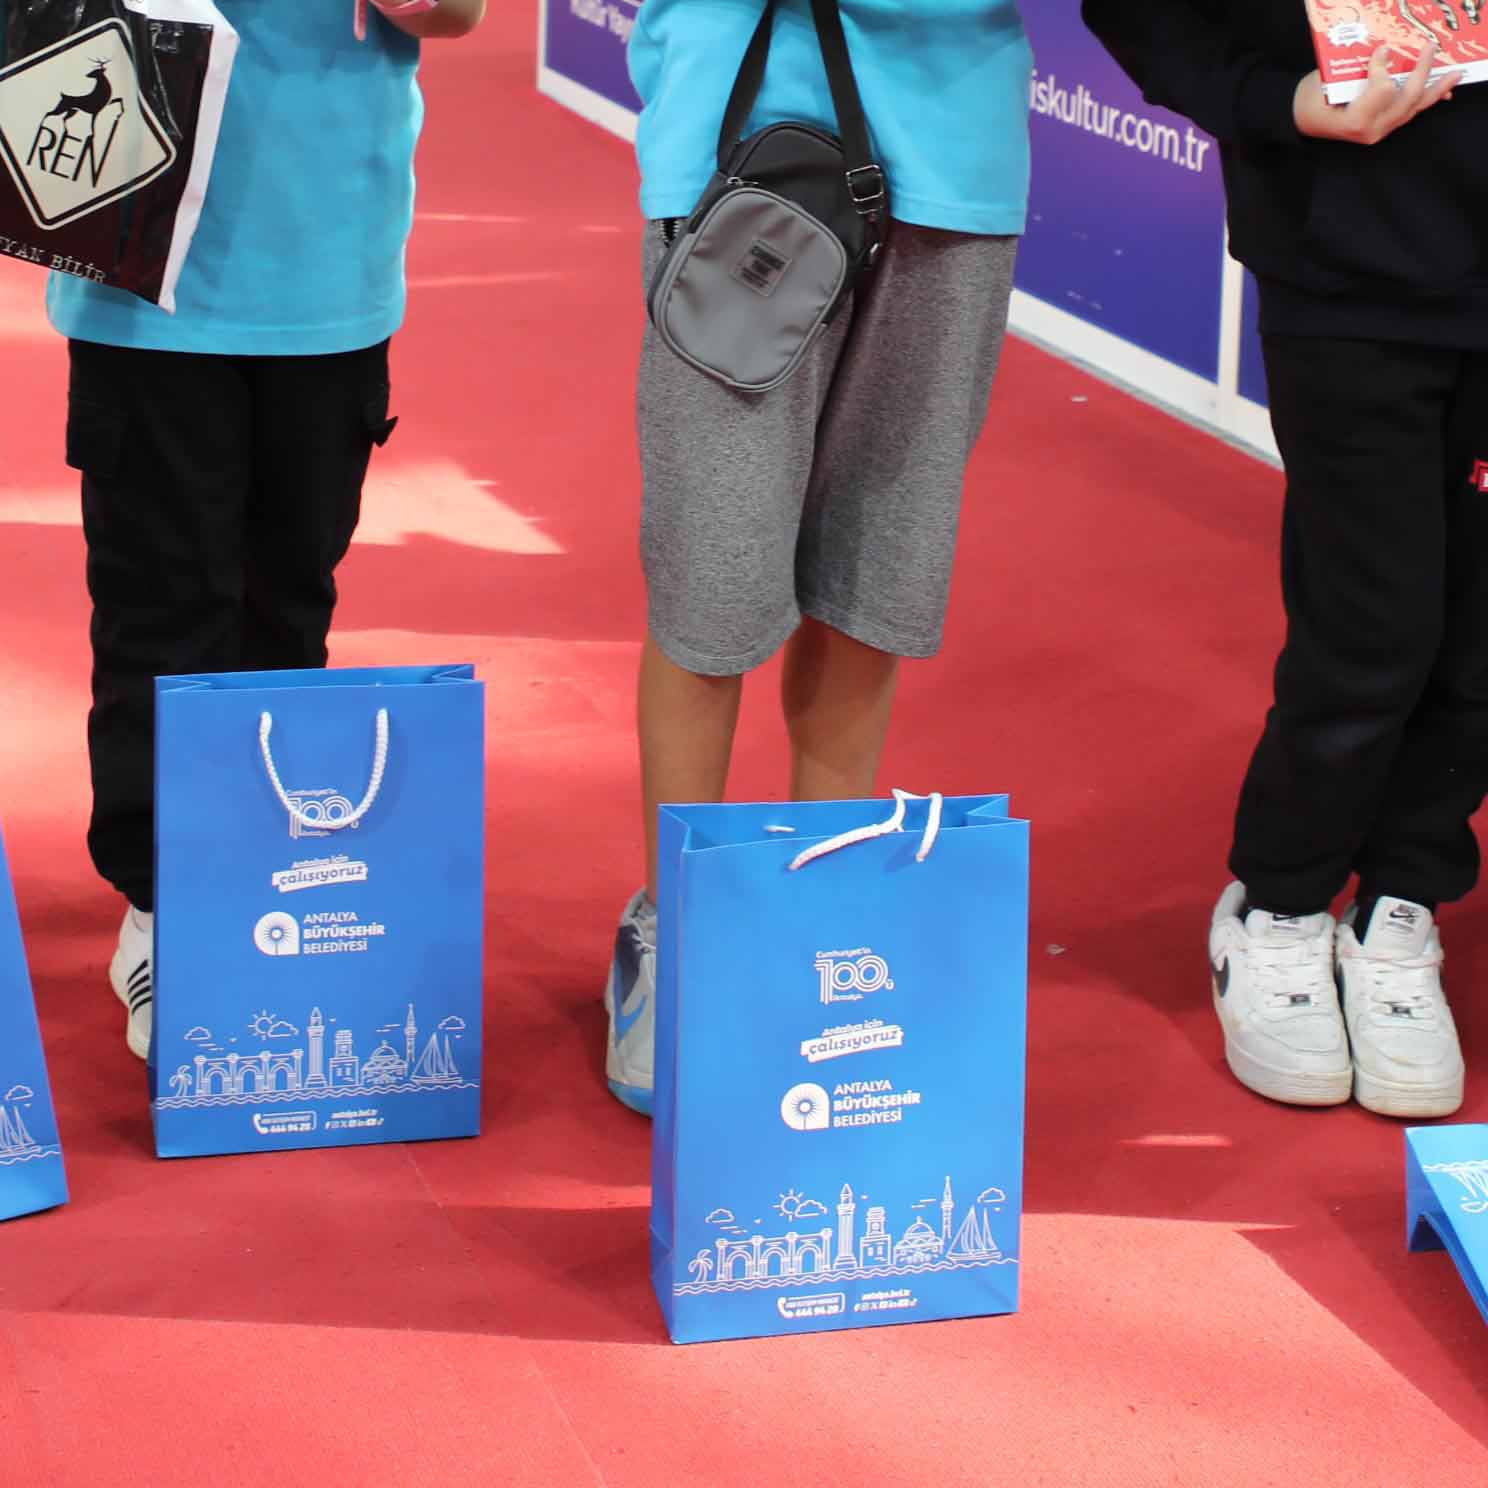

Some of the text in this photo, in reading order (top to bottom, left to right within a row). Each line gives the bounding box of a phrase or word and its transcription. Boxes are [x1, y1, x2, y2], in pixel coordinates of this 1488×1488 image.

[26, 112, 124, 188] REN
[51, 251, 106, 283] BİLİR
[303, 912, 358, 923] ANTALYA
[303, 922, 385, 939] BÜYÜKŞEHİR
[303, 939, 368, 954] BELEDİYESİ
[834, 1079, 892, 1095] ANTALYA
[833, 1090, 921, 1111] BÜYÜKŞEHİR
[833, 1107, 902, 1128] BELEDİYESİ
